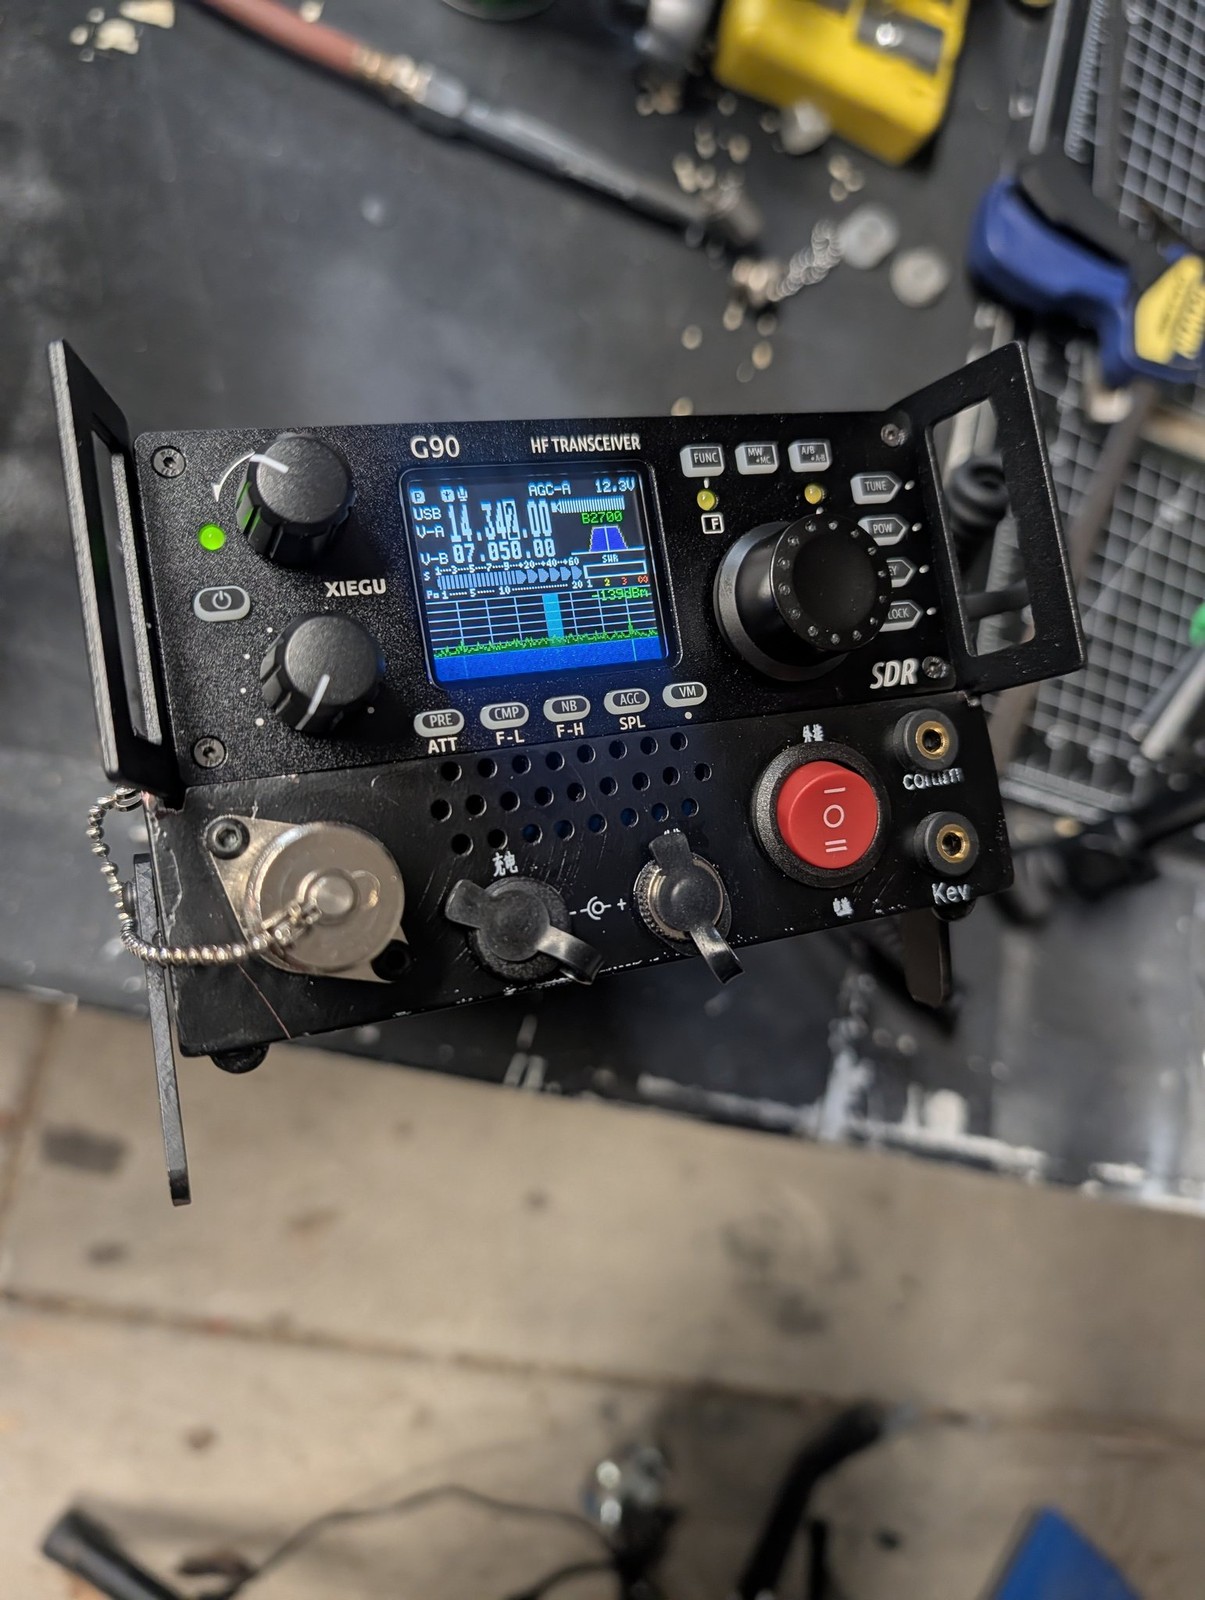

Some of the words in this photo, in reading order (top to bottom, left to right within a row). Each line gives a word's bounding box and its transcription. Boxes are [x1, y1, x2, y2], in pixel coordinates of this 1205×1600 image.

[410, 437, 460, 459] G90
[530, 437, 549, 453] HF
[551, 436, 641, 453] TRANSCEIVER
[801, 446, 815, 455] A/B
[693, 452, 718, 464] FUNC
[747, 447, 763, 457] MW
[528, 482, 572, 496] AGC-A
[595, 478, 635, 493] 12.3V
[864, 480, 887, 492] TUNE
[413, 506, 442, 520] USB
[581, 511, 623, 524] B2700
[416, 524, 445, 539] V-A
[872, 522, 893, 534] POW
[420, 552, 449, 566] V-B
[453, 539, 556, 563] 07.050.00
[602, 554, 619, 563] SWR
[324, 578, 387, 598] XIEGU
[572, 580, 583, 589] 20
[887, 607, 909, 620] LOCK
[870, 657, 919, 690] SDR
[678, 685, 697, 698] VM
[561, 700, 578, 712] NB
[619, 693, 641, 706] AGC
[428, 713, 453, 727] PRE
[494, 707, 519, 720] CMP
[619, 715, 646, 730] SPL
[556, 722, 584, 738] F-H
[495, 729, 525, 746] F-L
[428, 737, 458, 754] ATT
